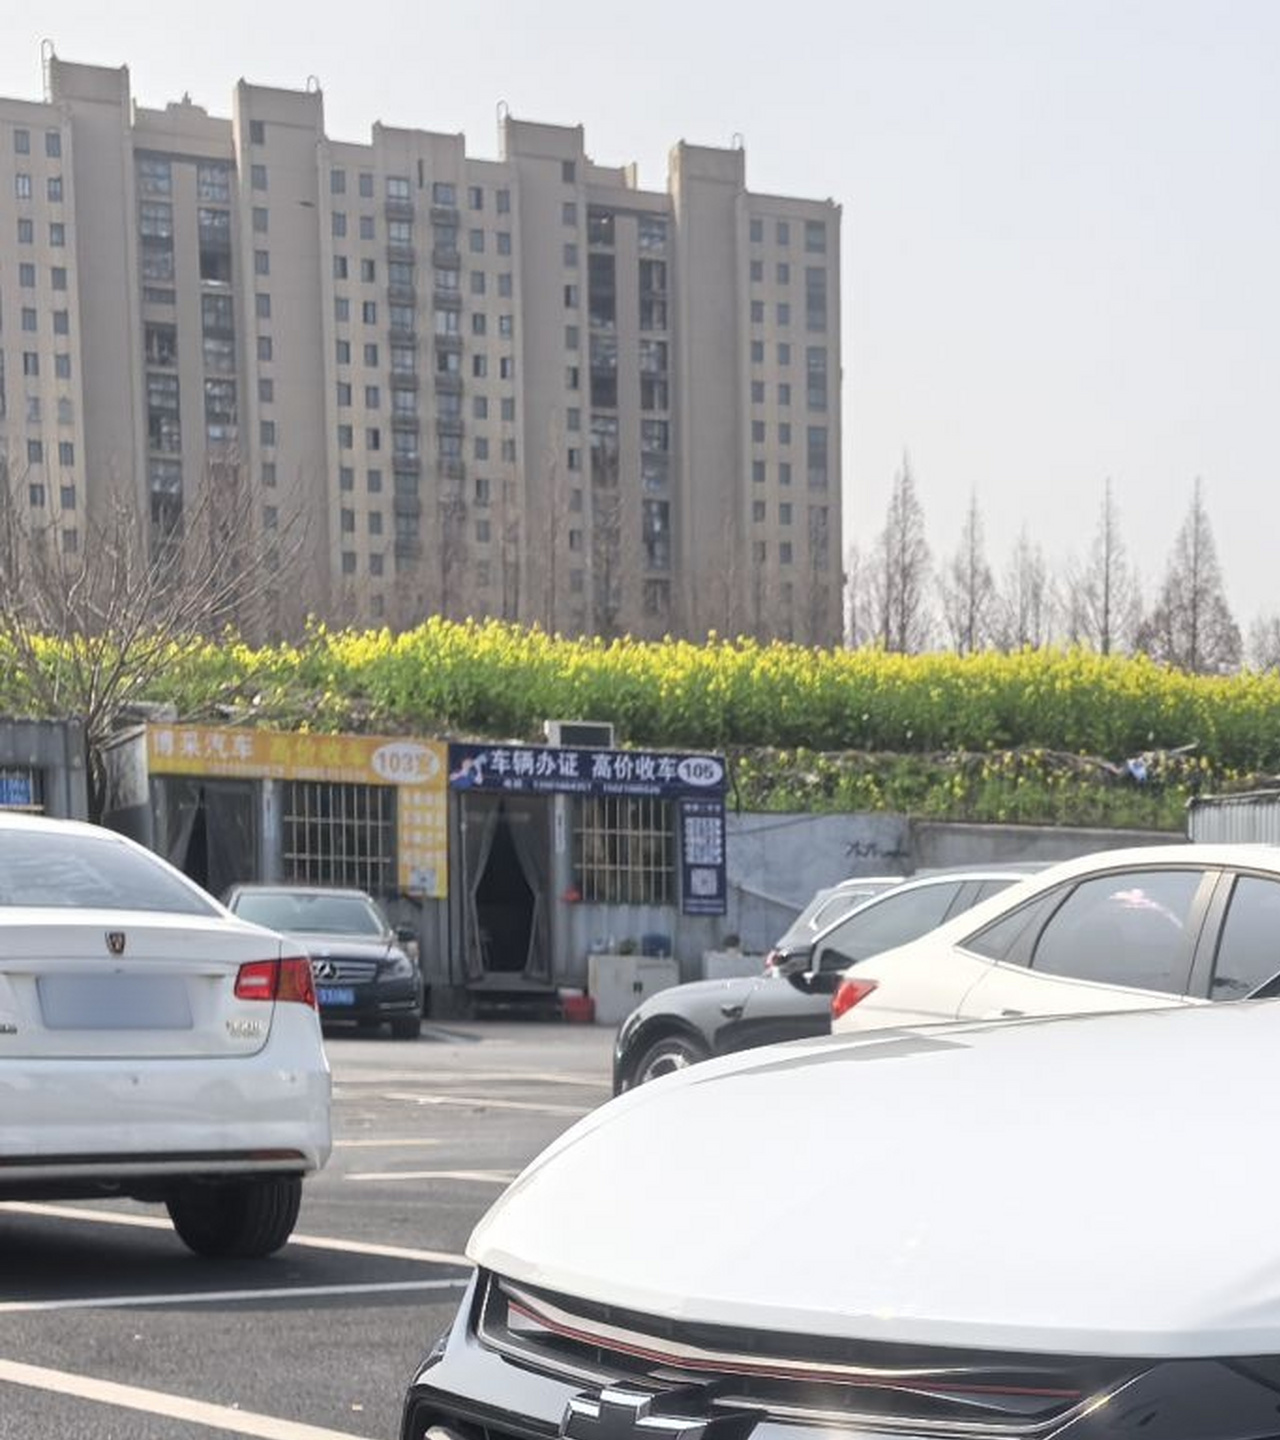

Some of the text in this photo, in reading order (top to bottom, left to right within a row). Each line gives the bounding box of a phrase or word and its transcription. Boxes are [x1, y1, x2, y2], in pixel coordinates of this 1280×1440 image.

[490, 749, 677, 780] 车辆办证 高价收车
[684, 762, 715, 780] 105
